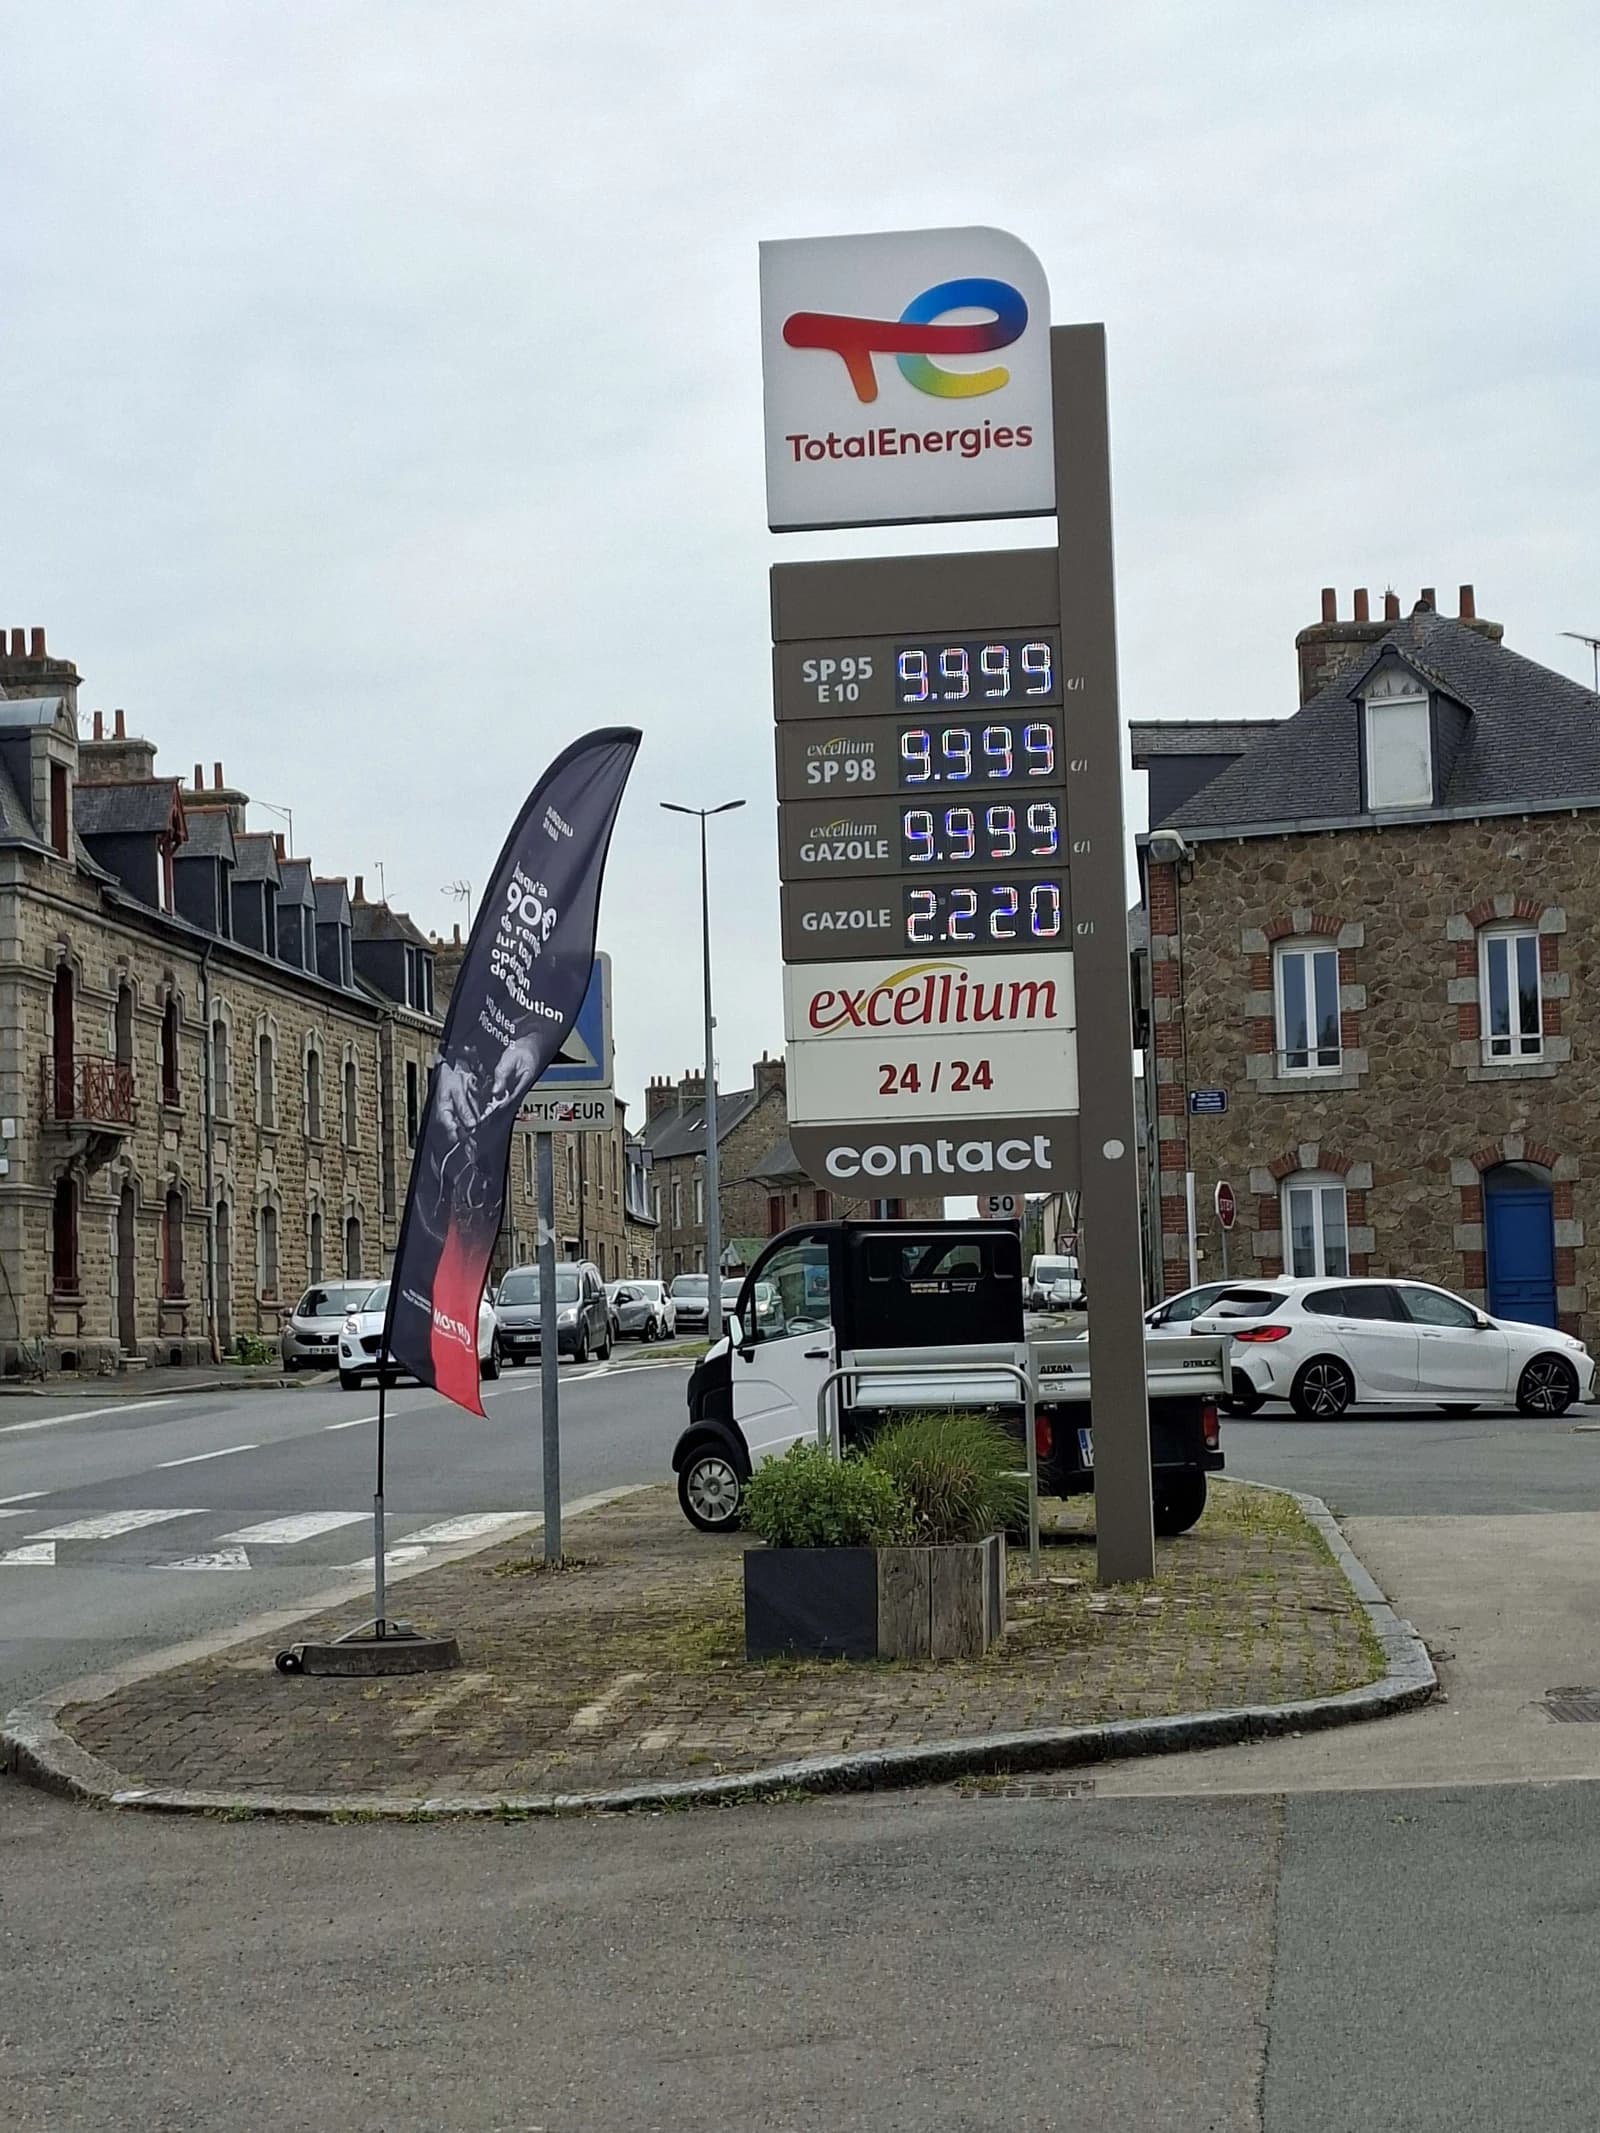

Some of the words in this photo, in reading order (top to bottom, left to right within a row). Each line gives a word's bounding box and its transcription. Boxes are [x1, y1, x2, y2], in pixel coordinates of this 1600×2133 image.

[786, 420, 1033, 463] TotalEnergies
[899, 642, 1052, 702] 9.999
[807, 739, 874, 756] excellium
[901, 723, 1055, 783] 9.999
[800, 840, 889, 862] GAZOLE
[810, 821, 877, 838] excellium
[904, 802, 1058, 862] 9.999
[802, 909, 892, 931] GAZOLE
[907, 882, 1060, 942] 2.220
[809, 970, 1058, 1030] excellium
[514, 1101, 605, 1121] NTISEUR
[825, 1135, 1052, 1178] contact
[989, 1196, 1014, 1212] 50
